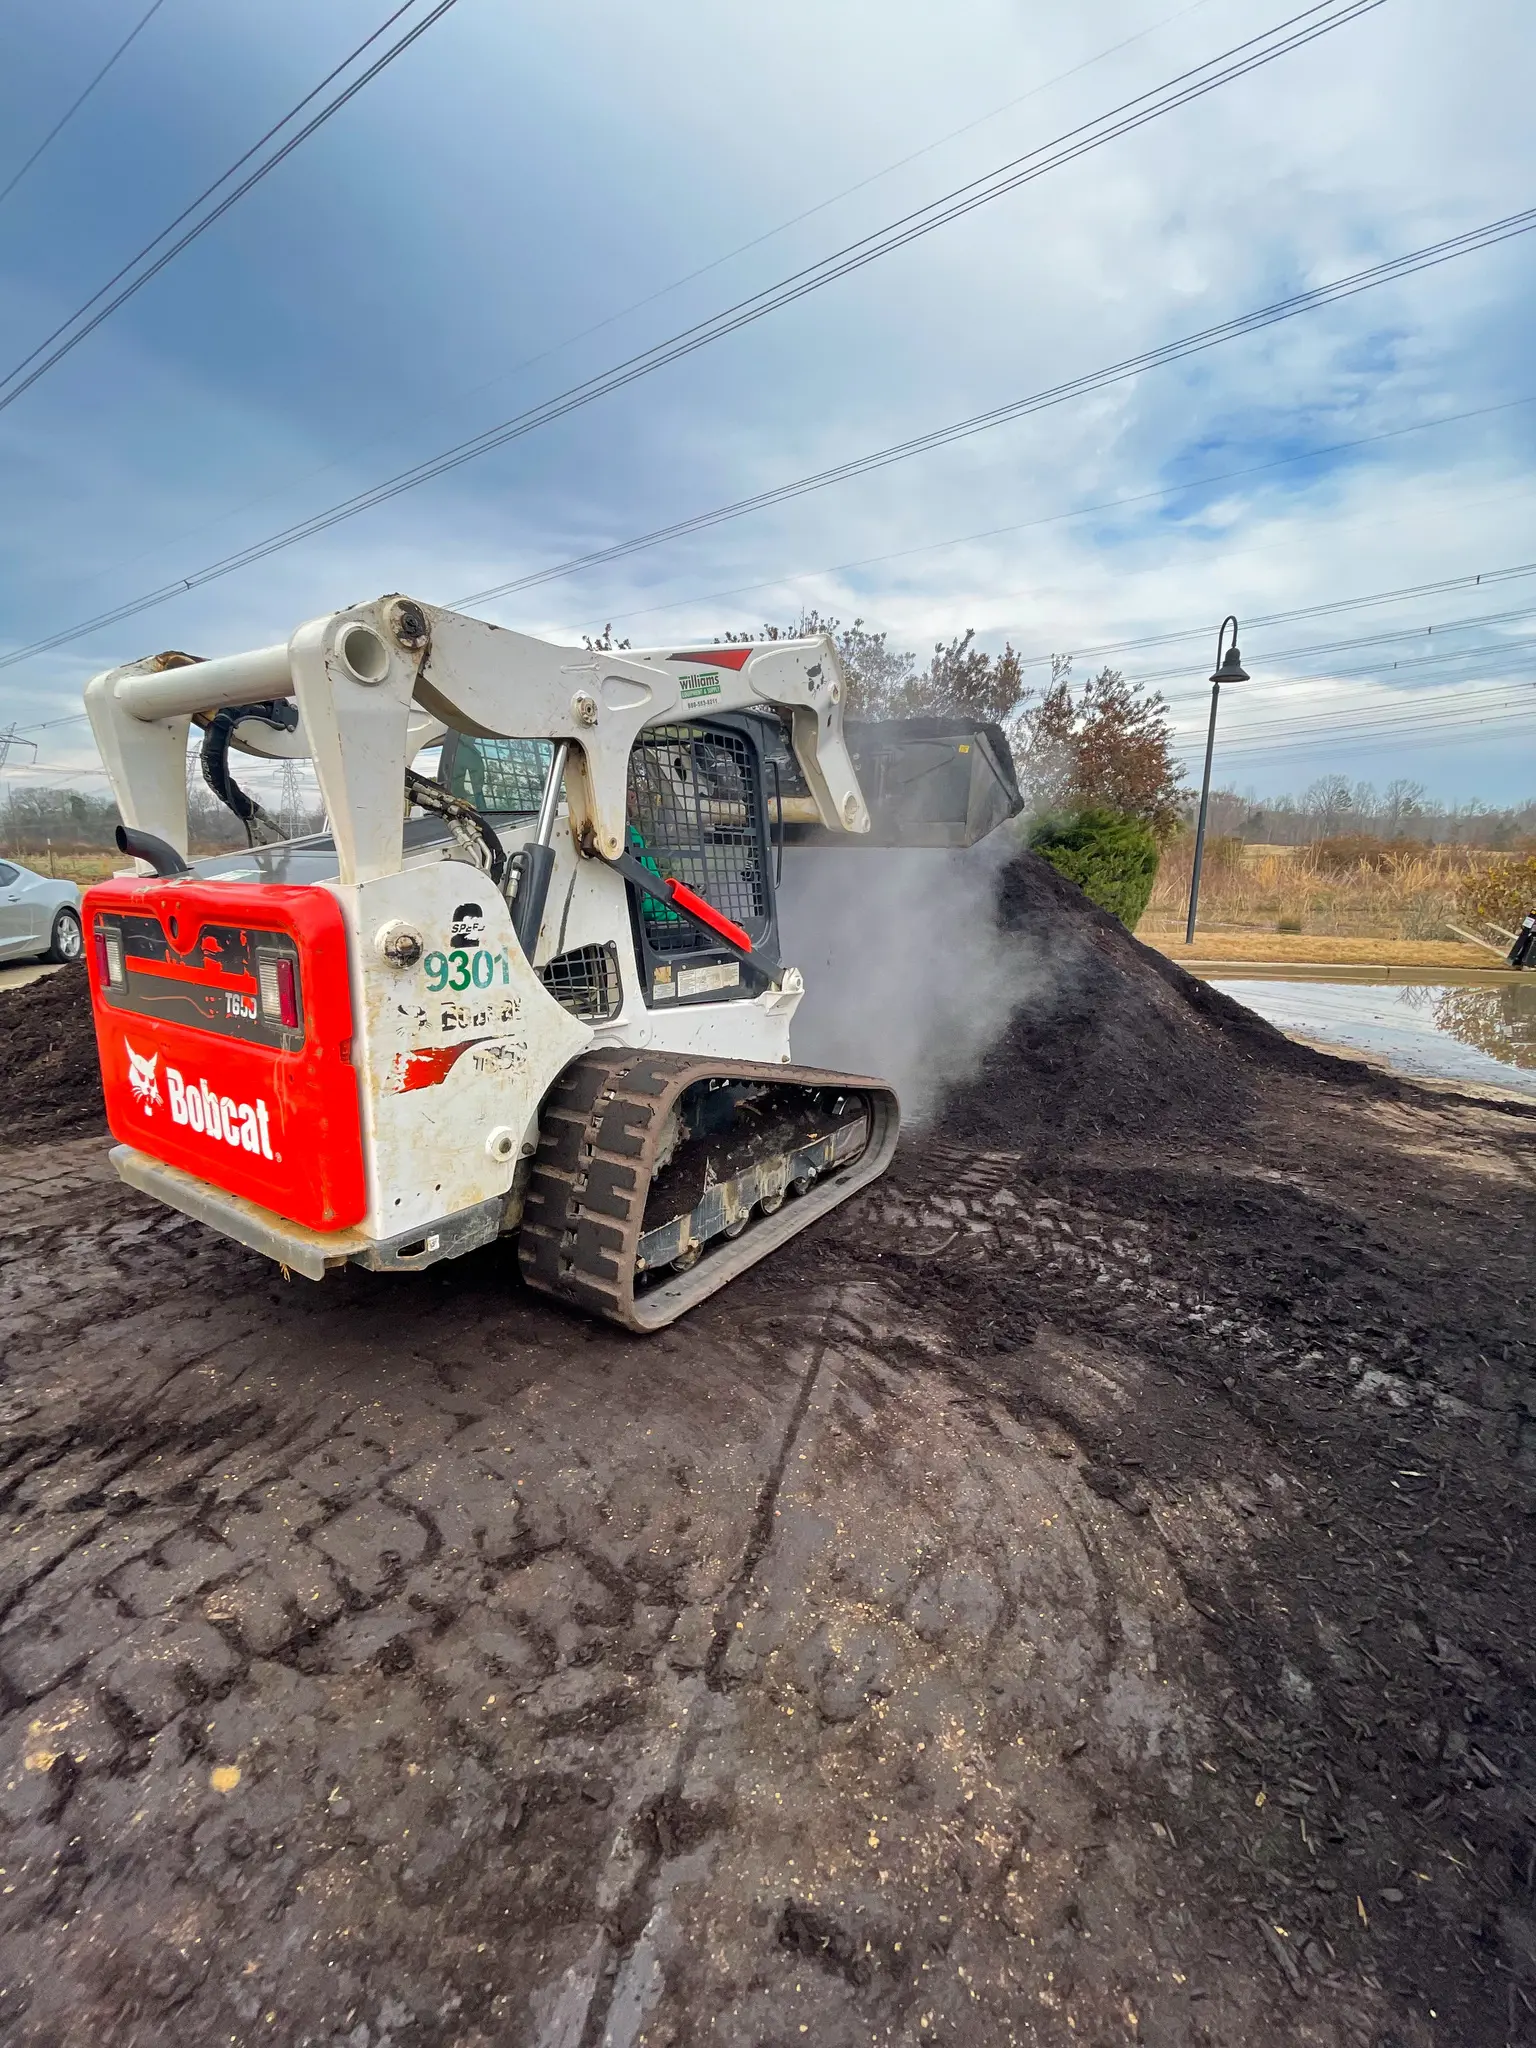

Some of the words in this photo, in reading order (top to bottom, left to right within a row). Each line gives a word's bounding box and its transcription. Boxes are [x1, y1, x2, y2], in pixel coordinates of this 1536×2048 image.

[679, 675, 719, 690] williams
[424, 946, 510, 992] 9301
[165, 1067, 274, 1160] Bobcat
